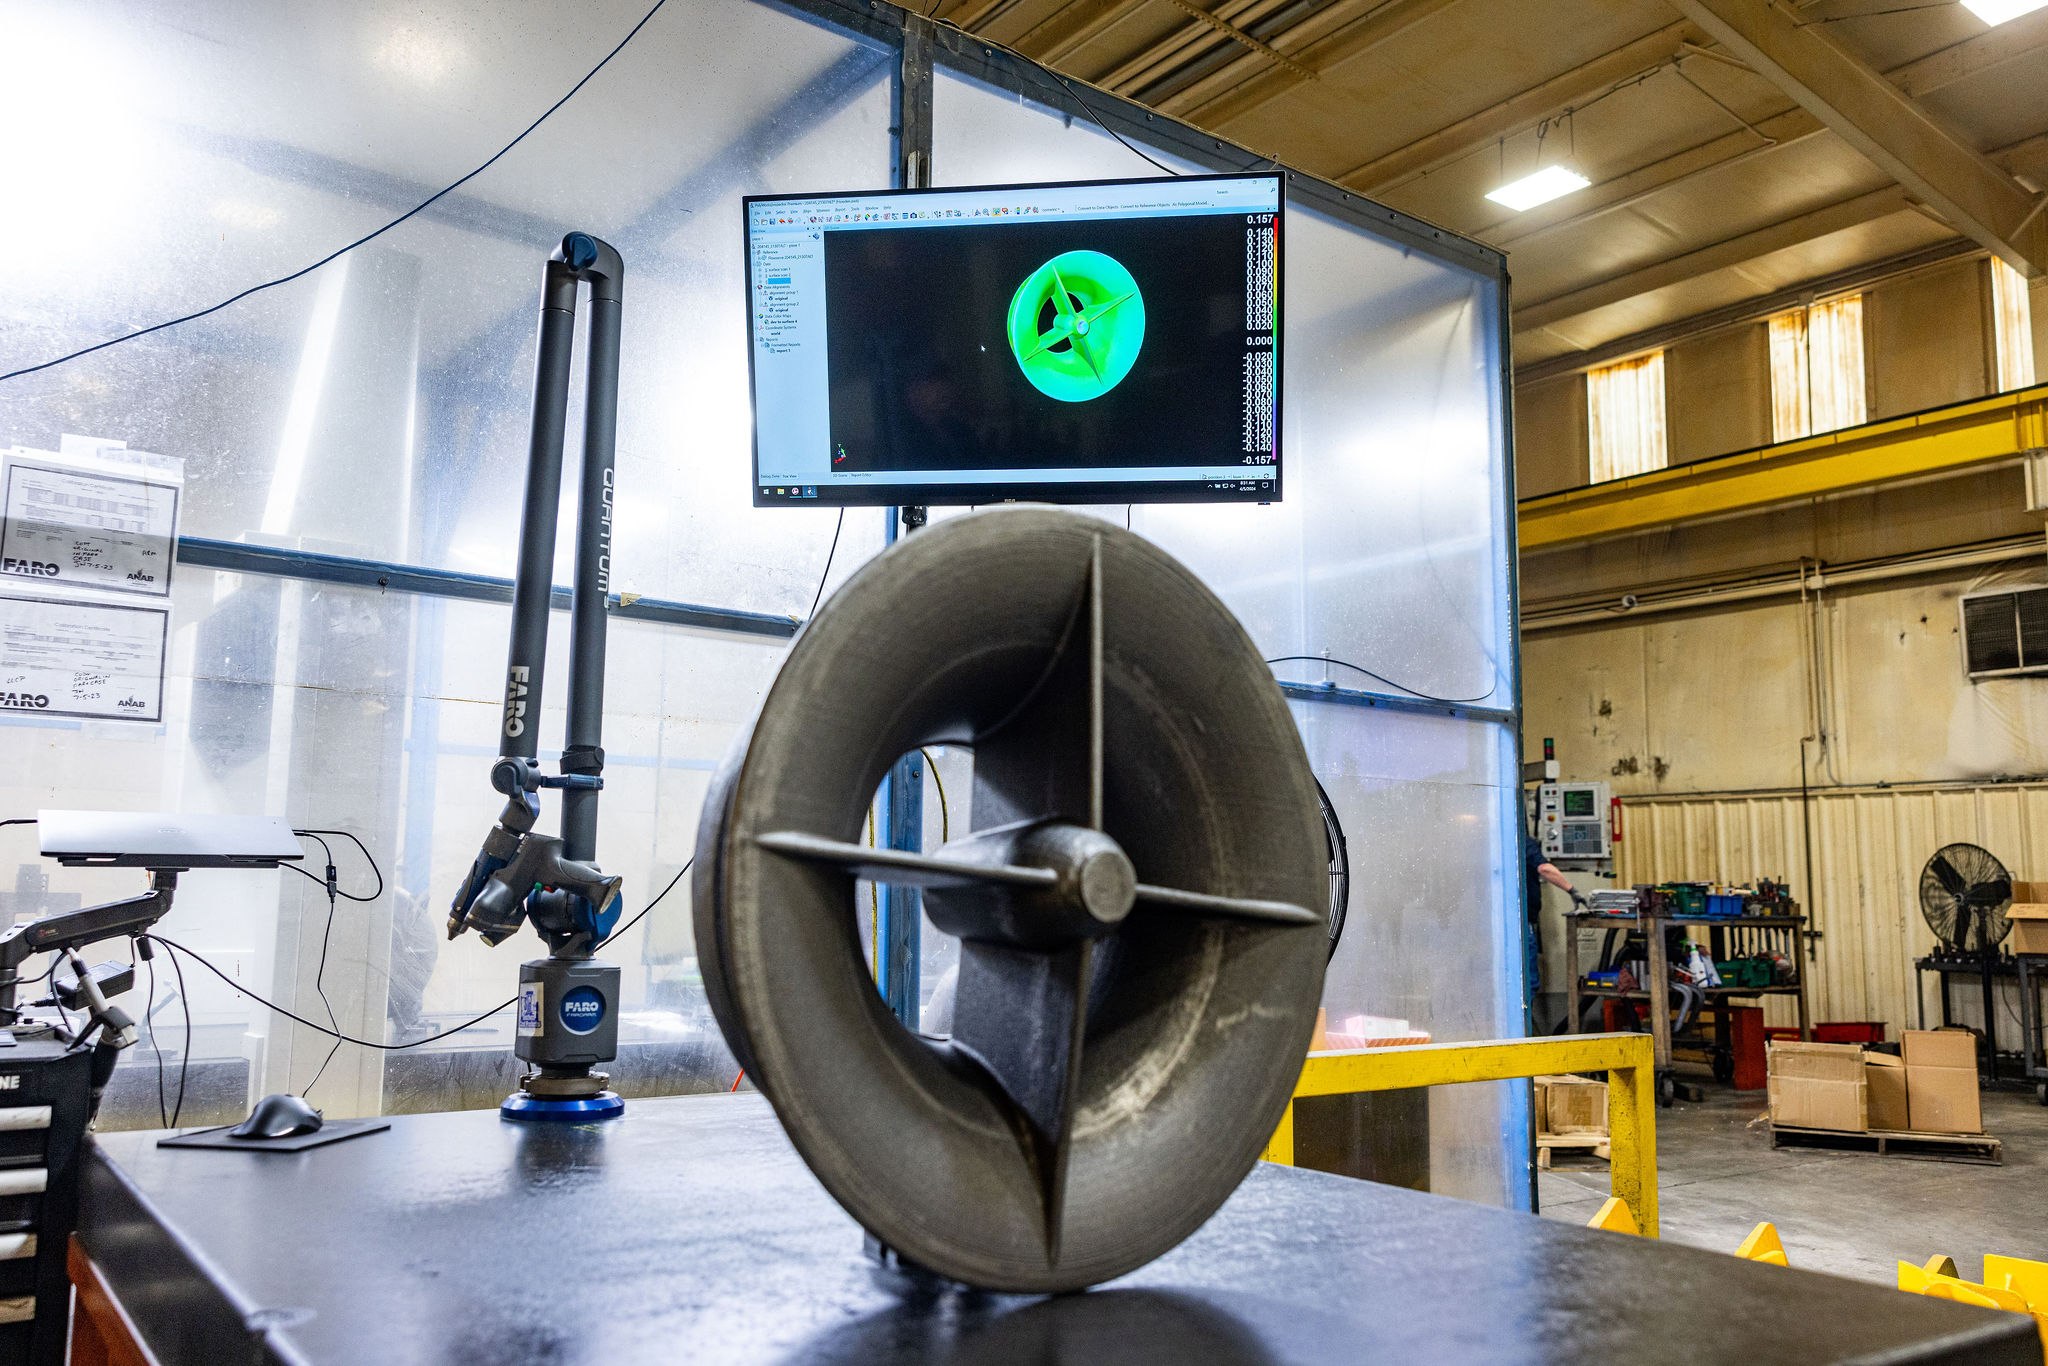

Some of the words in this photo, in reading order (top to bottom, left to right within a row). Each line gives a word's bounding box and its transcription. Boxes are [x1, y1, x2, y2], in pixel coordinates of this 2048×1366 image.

[1247, 214, 1273, 224] 0.157
[1247, 228, 1273, 237] 0.140
[1247, 321, 1272, 330] 0.020
[1247, 336, 1272, 346] 0.000
[1242, 352, 1272, 361] -0.020
[1242, 443, 1272, 452] -0.140
[1242, 456, 1272, 465] -0.157
[598, 468, 613, 592] QUANTUM
[3, 558, 60, 576] FARO
[127, 573, 154, 582] ANAB
[506, 666, 530, 737] FARO
[565, 1002, 598, 1012] FARO
